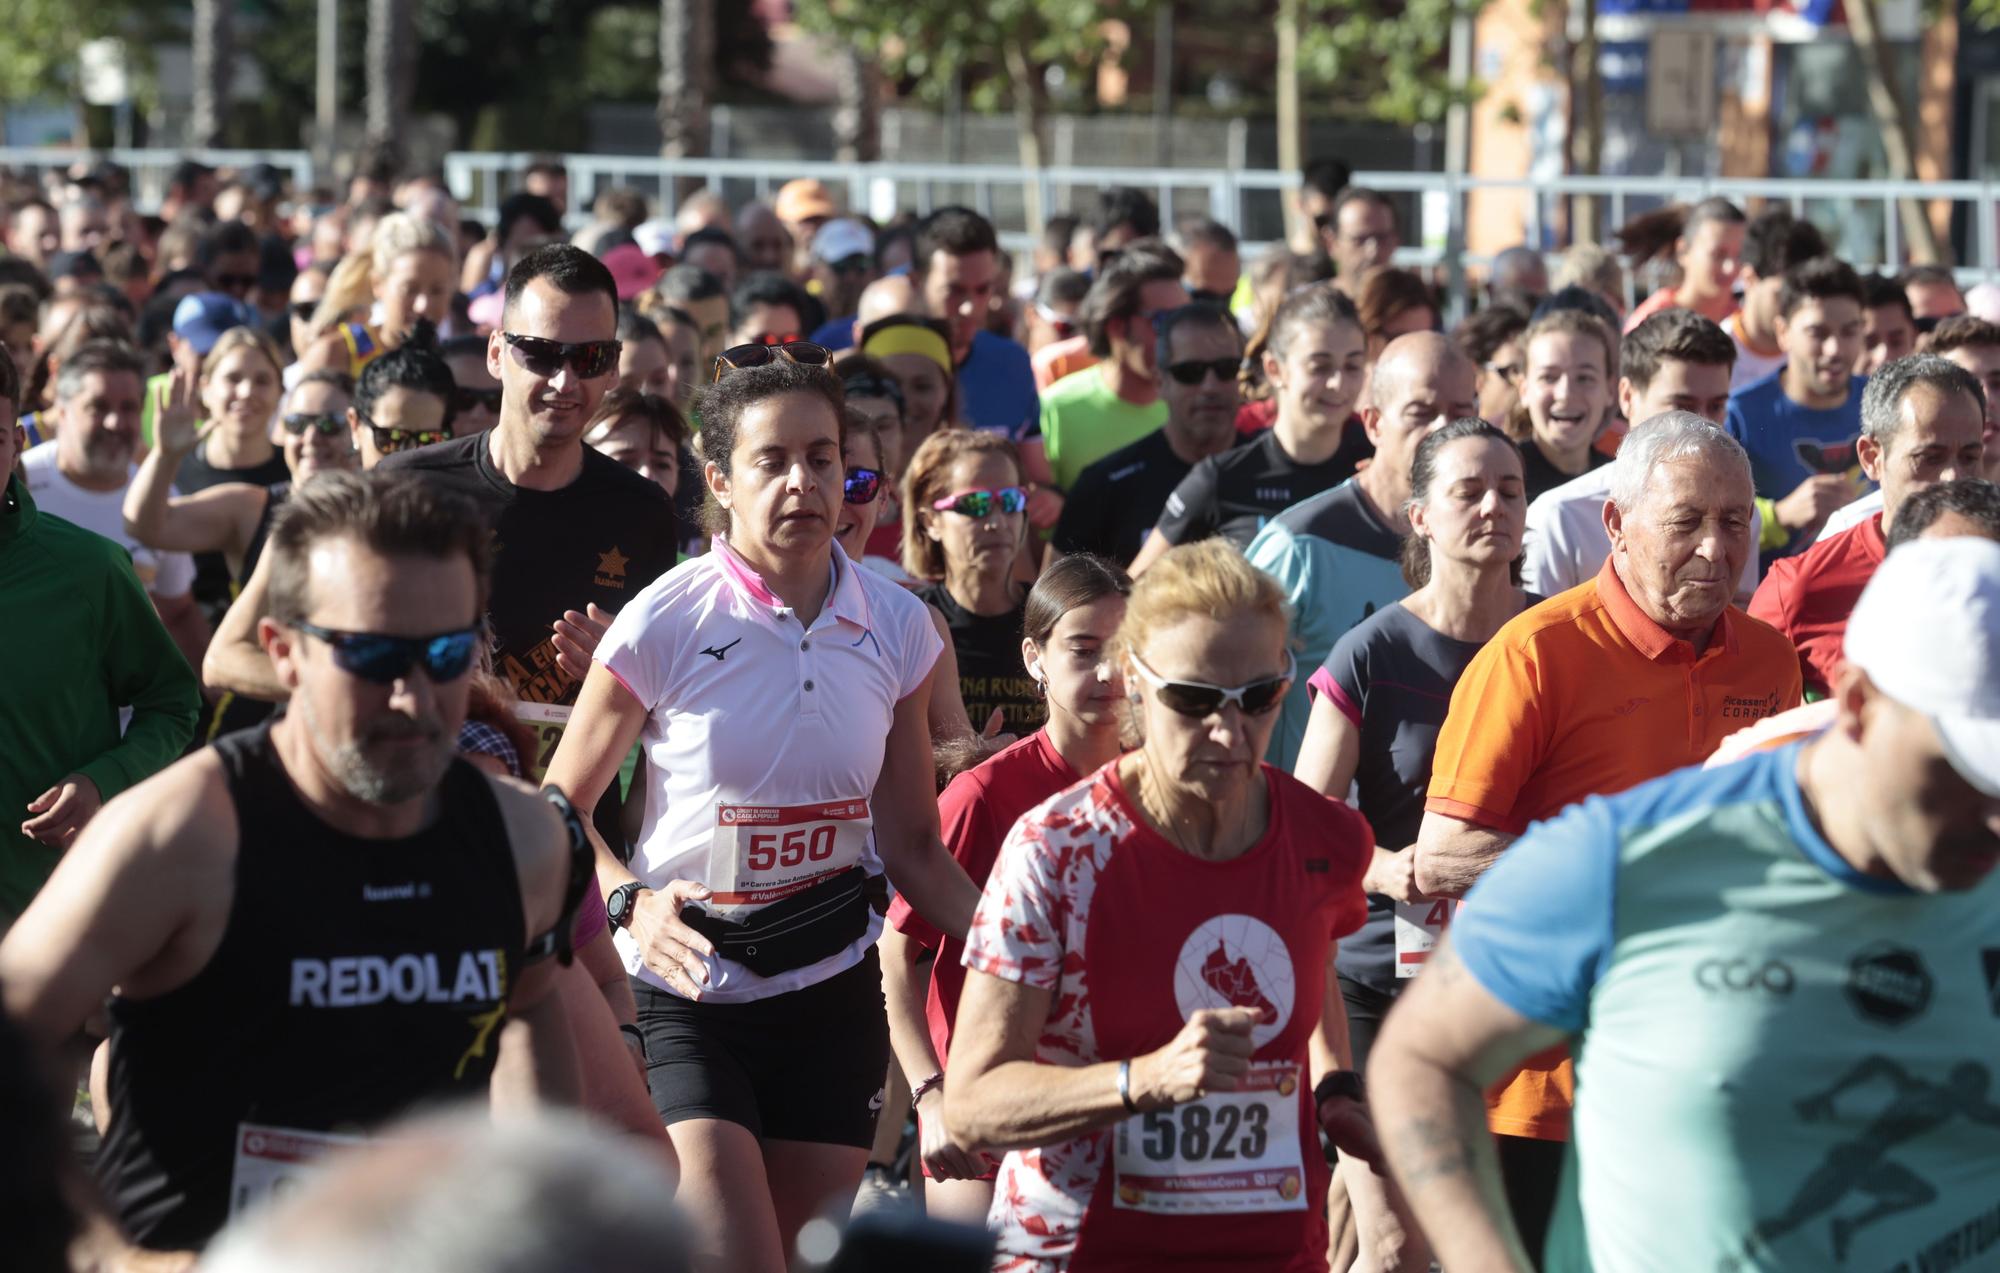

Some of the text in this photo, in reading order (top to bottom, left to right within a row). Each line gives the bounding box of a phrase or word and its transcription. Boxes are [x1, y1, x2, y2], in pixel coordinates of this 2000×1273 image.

[748, 825, 837, 871] 550
[750, 881, 776, 889] Carrera
[776, 877, 792, 885] Jose
[290, 948, 504, 1007] REDOLAT
[1142, 1103, 1270, 1163] 5823
